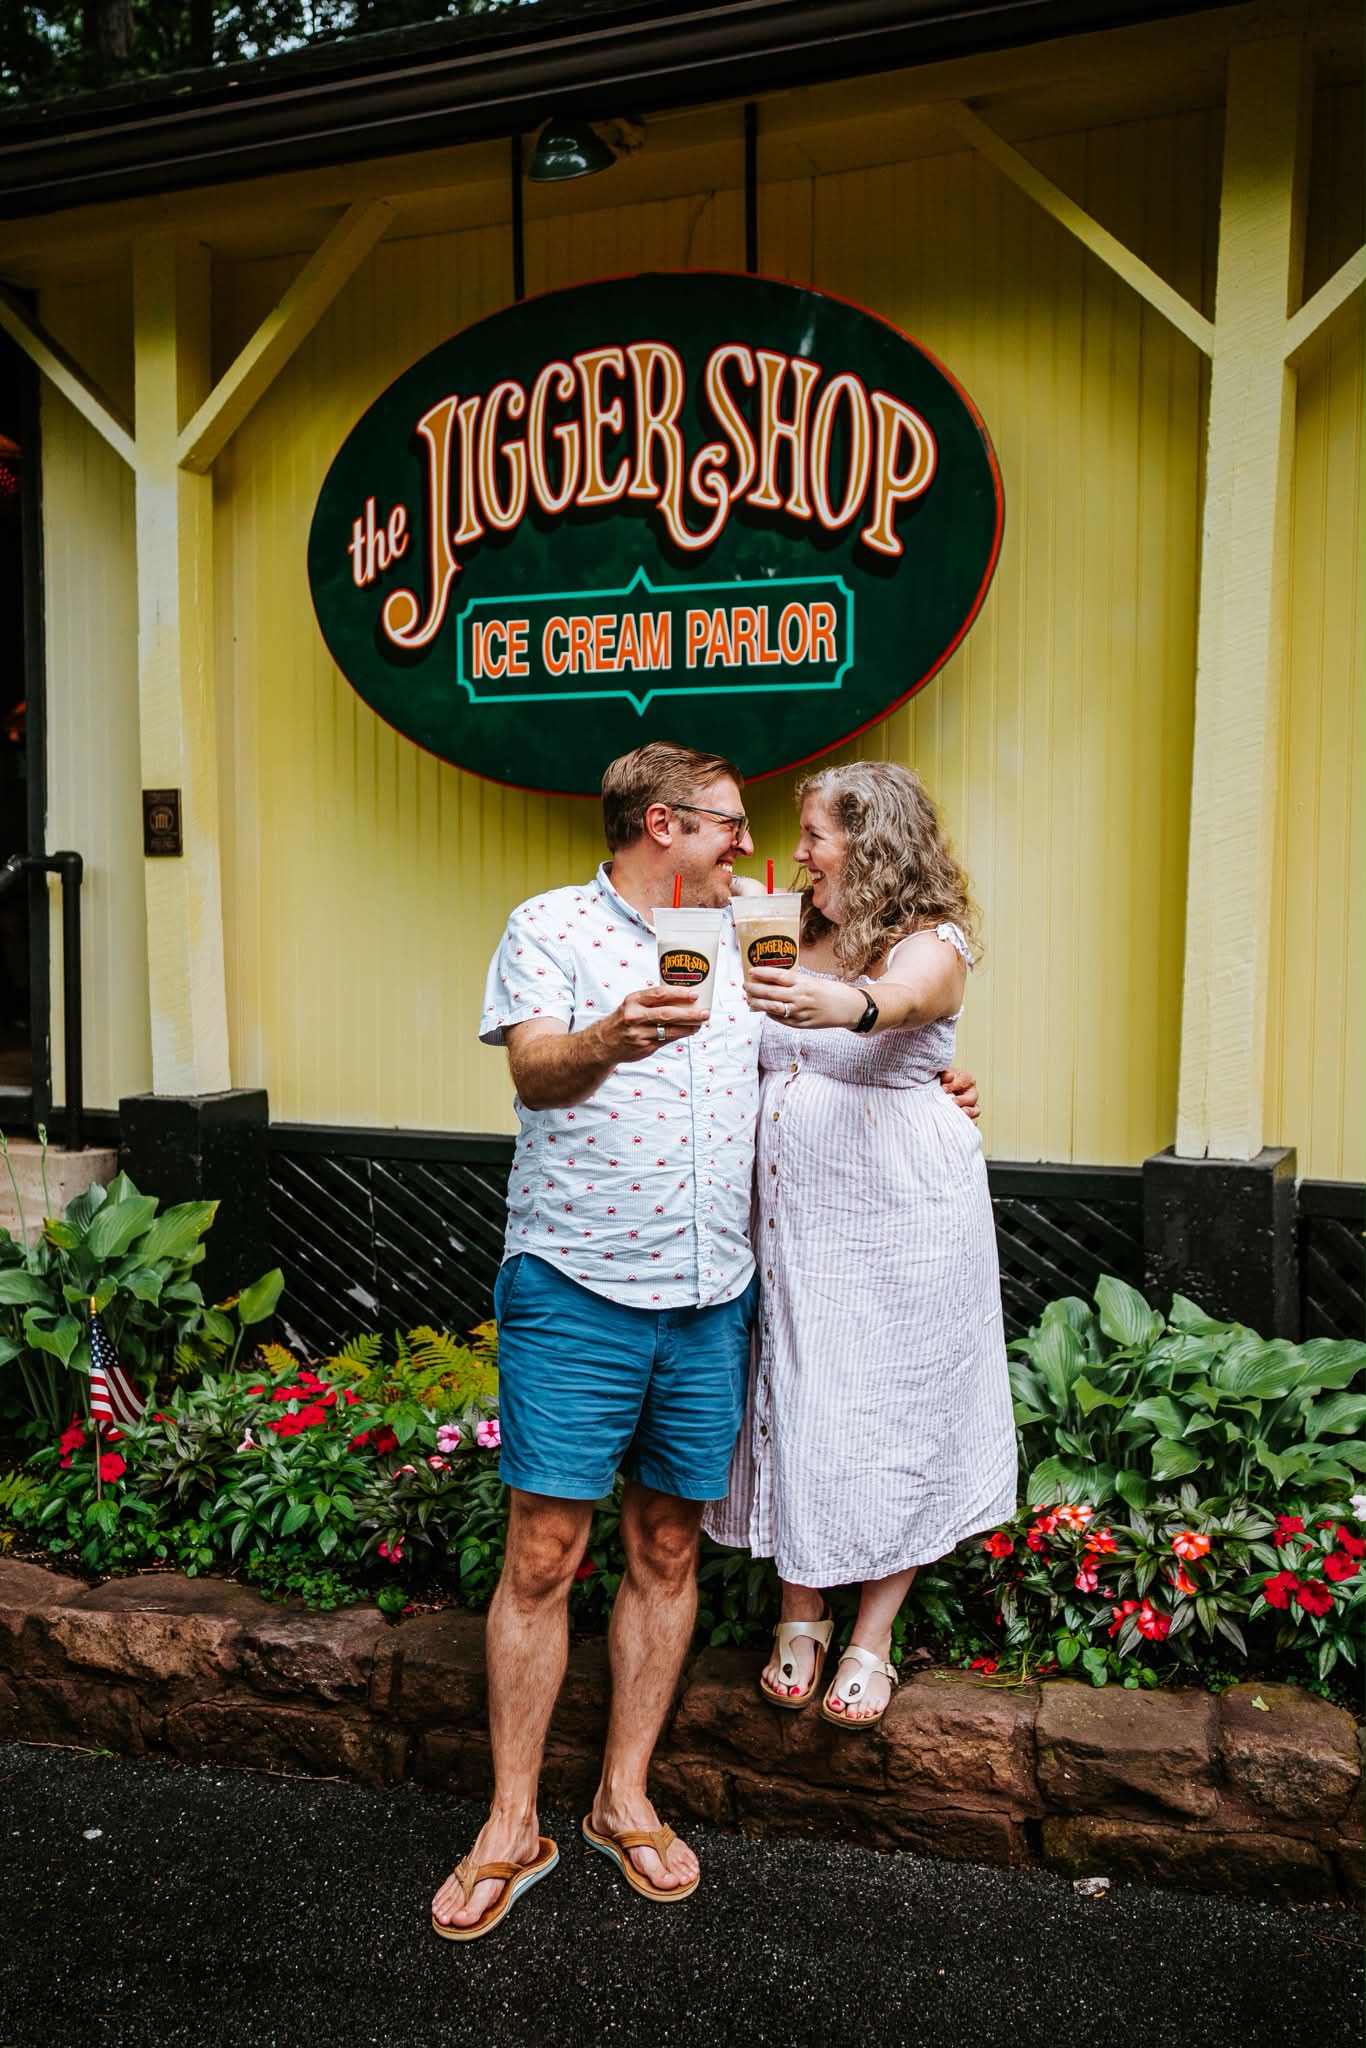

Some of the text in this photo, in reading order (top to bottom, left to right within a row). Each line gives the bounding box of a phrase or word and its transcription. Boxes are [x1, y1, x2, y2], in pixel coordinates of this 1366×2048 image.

[348, 339, 937, 649] the JIGGER SHOP
[472, 601, 838, 680] ICE CREAM PARLOR
[662, 953, 695, 976] JIGGER
[752, 939, 787, 963] JIGGER
